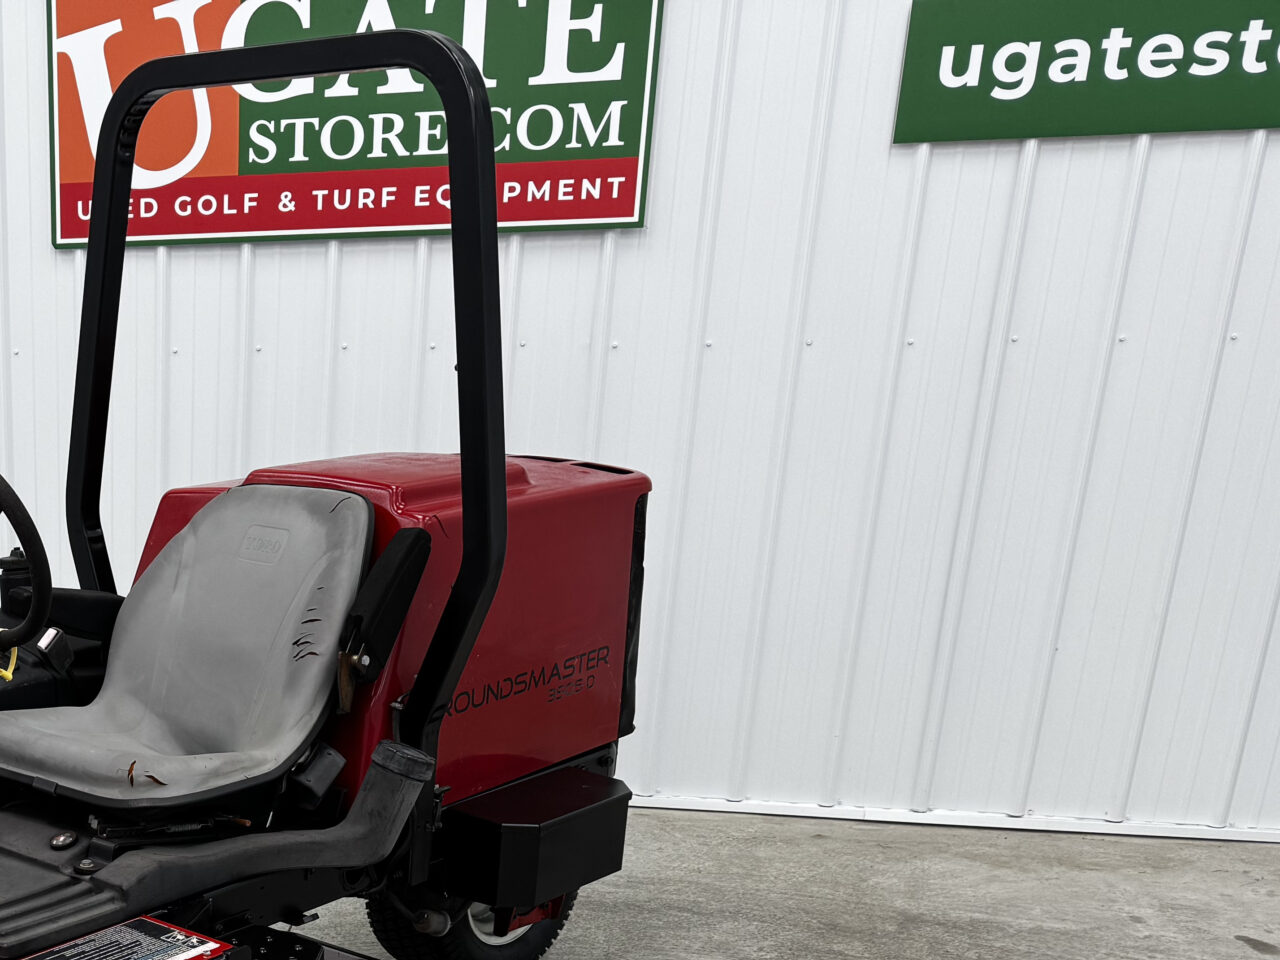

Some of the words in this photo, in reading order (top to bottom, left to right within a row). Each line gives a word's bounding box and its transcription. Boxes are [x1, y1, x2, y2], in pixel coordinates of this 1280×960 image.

[938, 19, 1280, 100] ugatest
[174, 192, 260, 217] GOLF
[278, 190, 297, 213] &
[312, 186, 398, 211] TURF
[414, 177, 626, 210] EQPMENT
